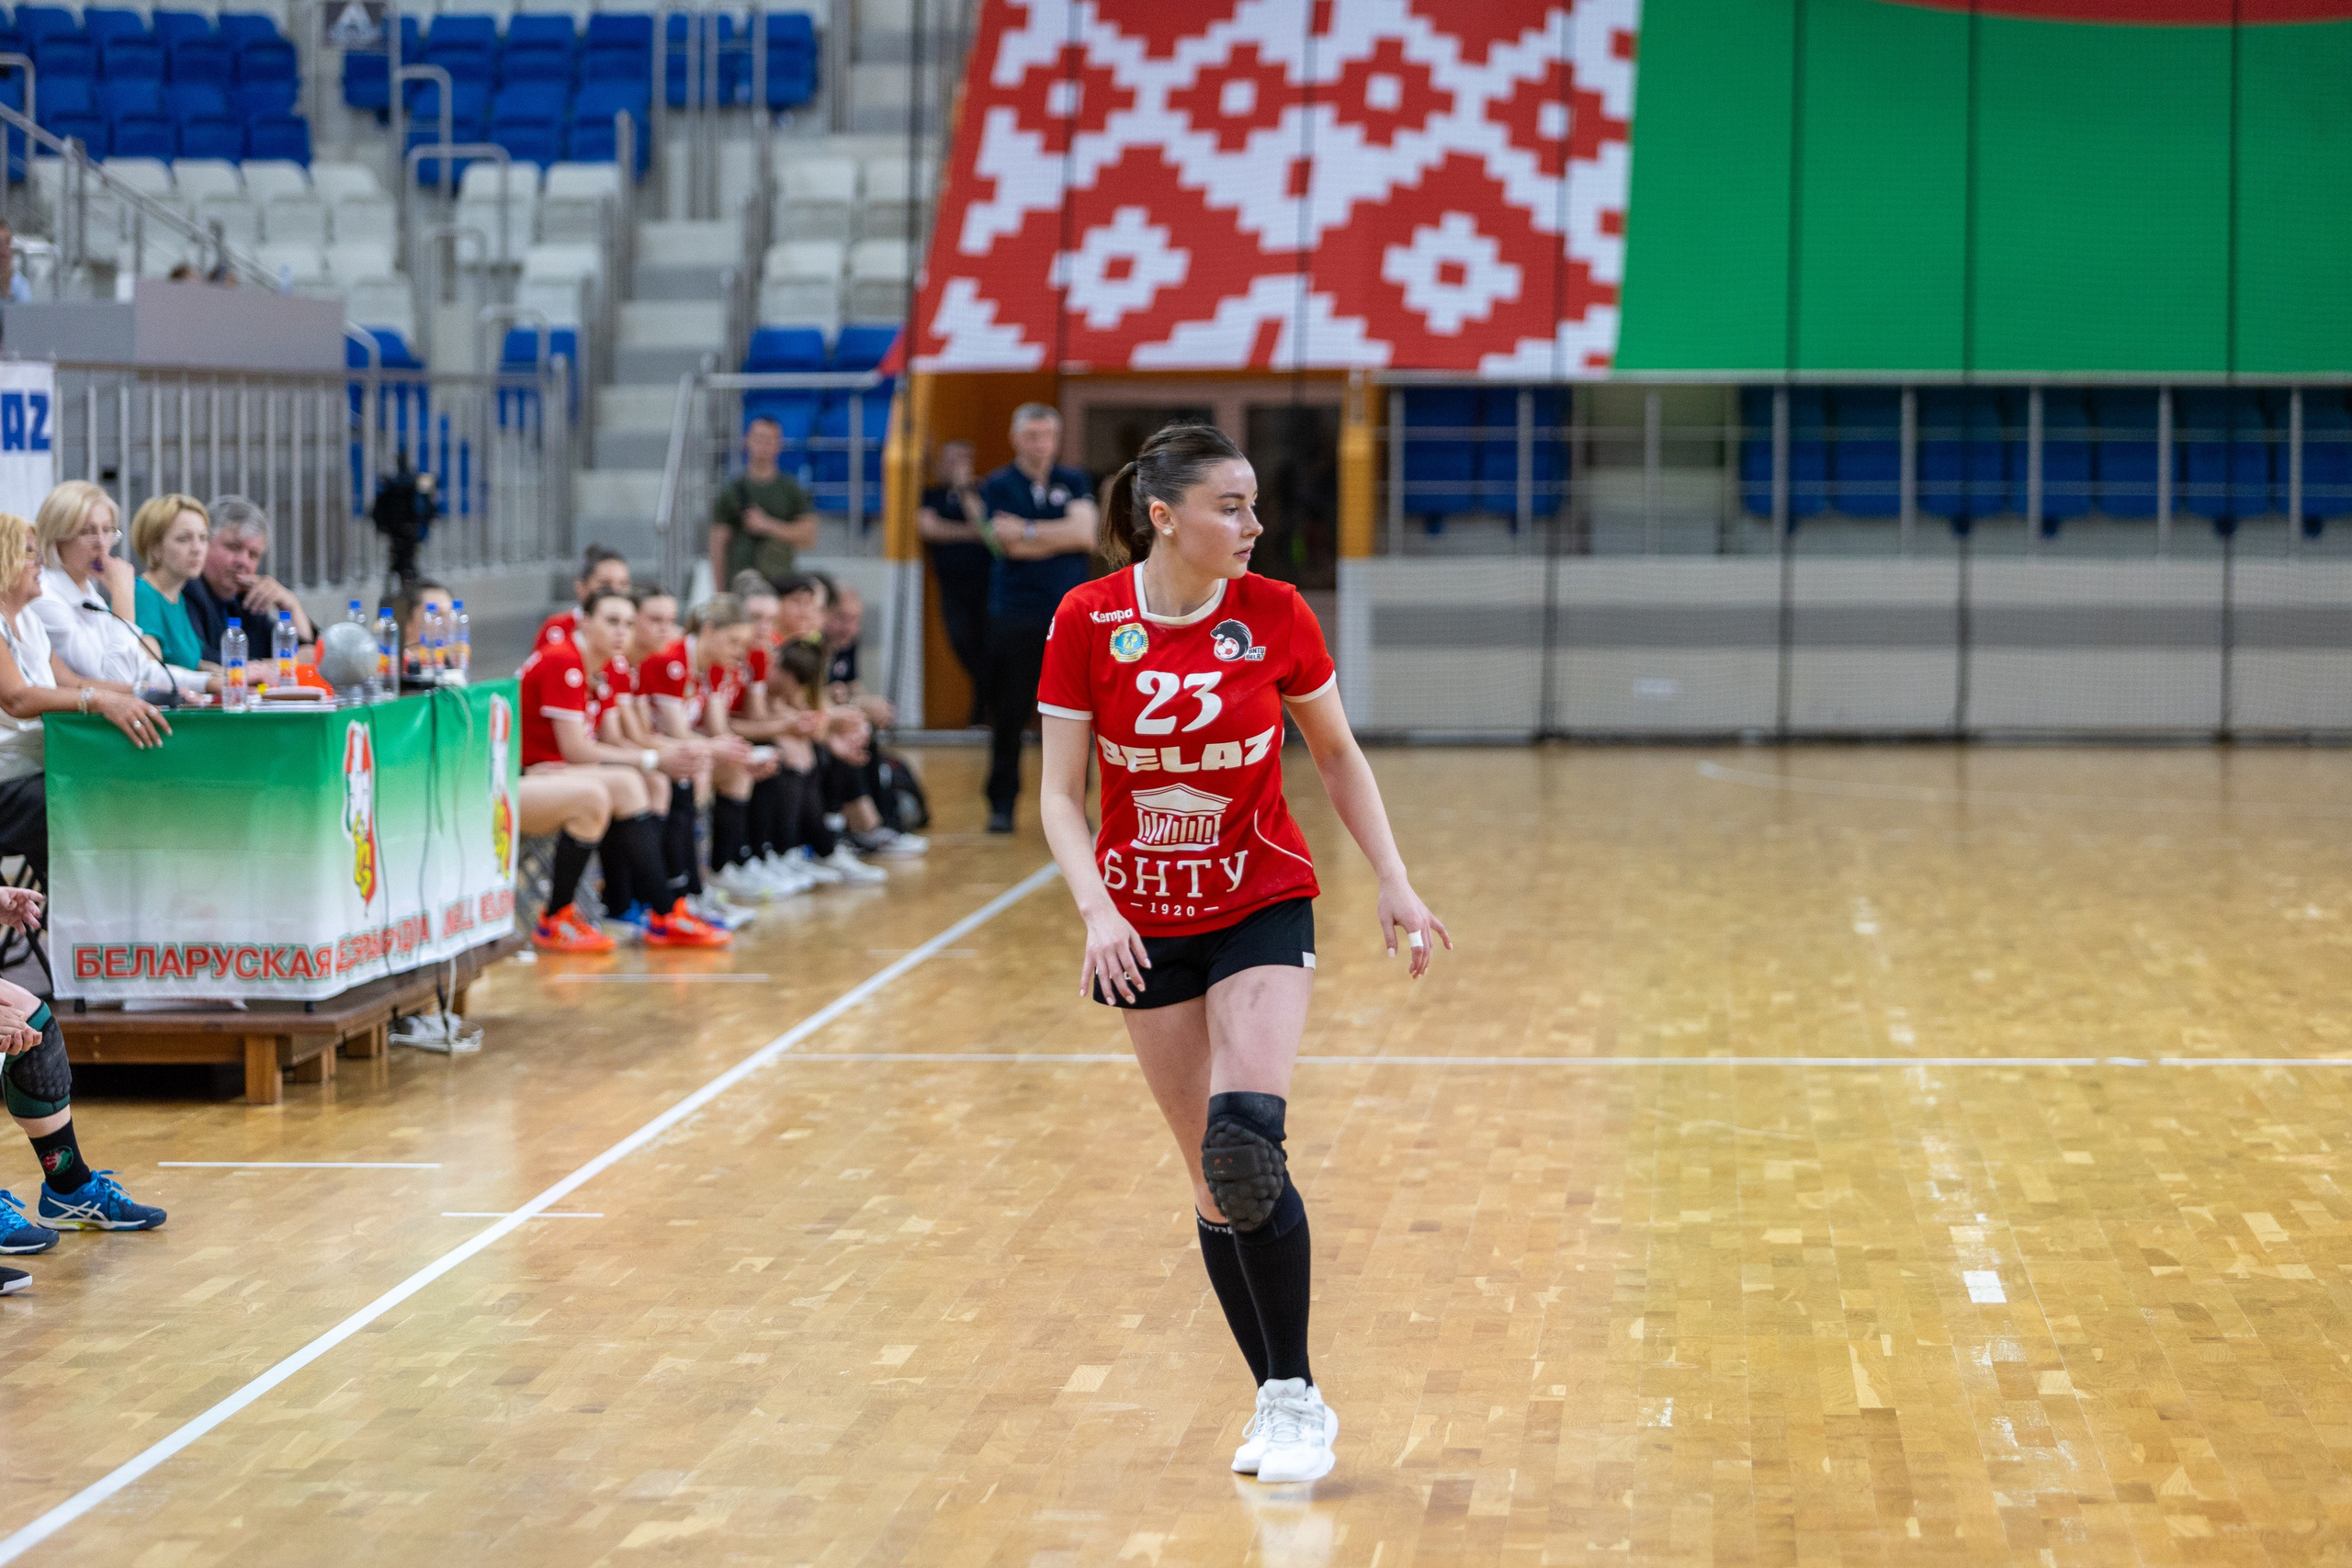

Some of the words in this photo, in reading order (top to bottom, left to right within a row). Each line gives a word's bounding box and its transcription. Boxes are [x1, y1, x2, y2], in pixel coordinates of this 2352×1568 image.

[1089, 607, 1134, 625] Kempa
[1134, 671, 1223, 735] 23
[1098, 725, 1276, 773] BELAZ
[1102, 847, 1249, 898] БНТУ
[1149, 901, 1195, 918] 1920
[74, 944, 332, 980] БЕЛАРУСКАЯ
